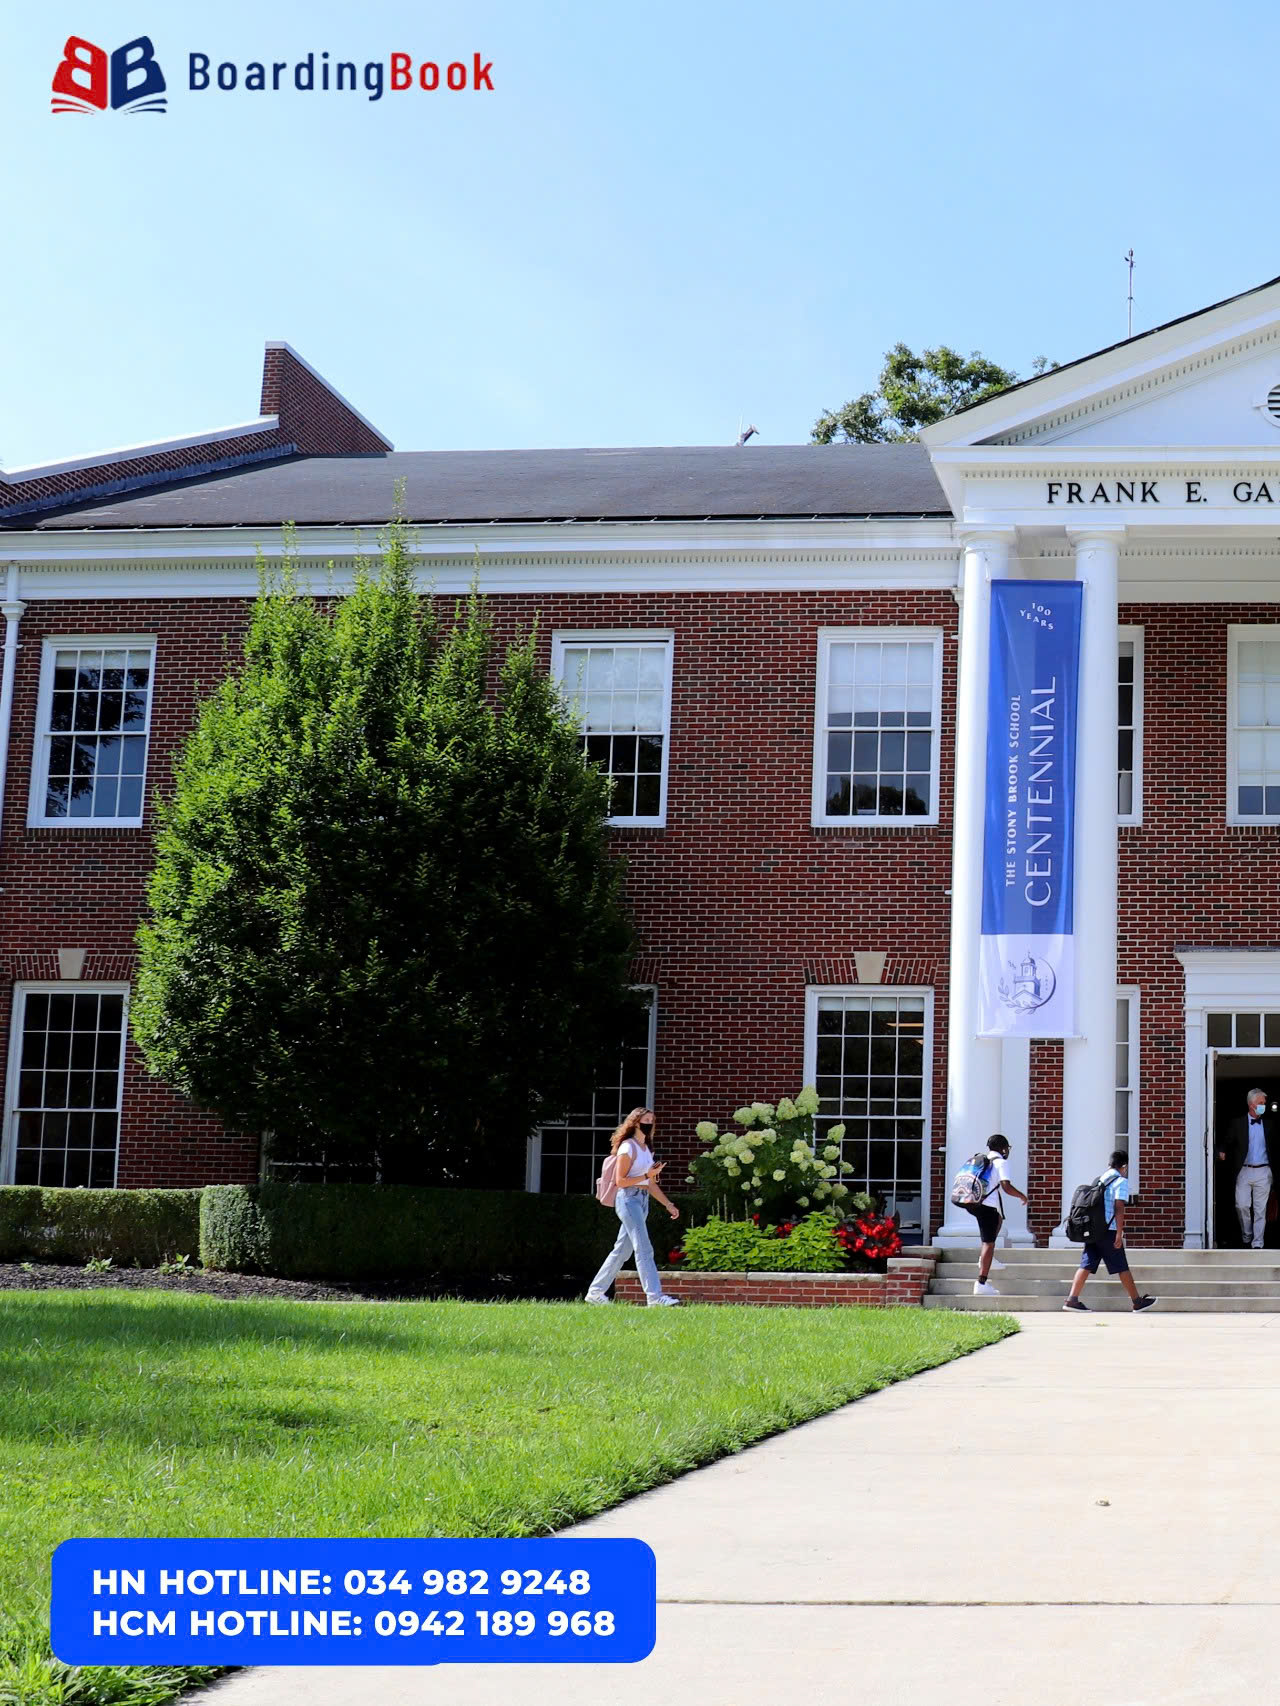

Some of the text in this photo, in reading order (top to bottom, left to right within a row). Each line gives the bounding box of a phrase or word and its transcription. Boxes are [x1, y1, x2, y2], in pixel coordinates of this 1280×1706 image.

[1047, 481, 1159, 503] FRANK
[1186, 481, 1208, 502] E.
[1019, 609, 1054, 630] YEARS
[1031, 602, 1052, 616] 100
[1005, 695, 1021, 887] THE STONY BROOK SCHOOL
[1024, 676, 1056, 907] CENTENNIAL
